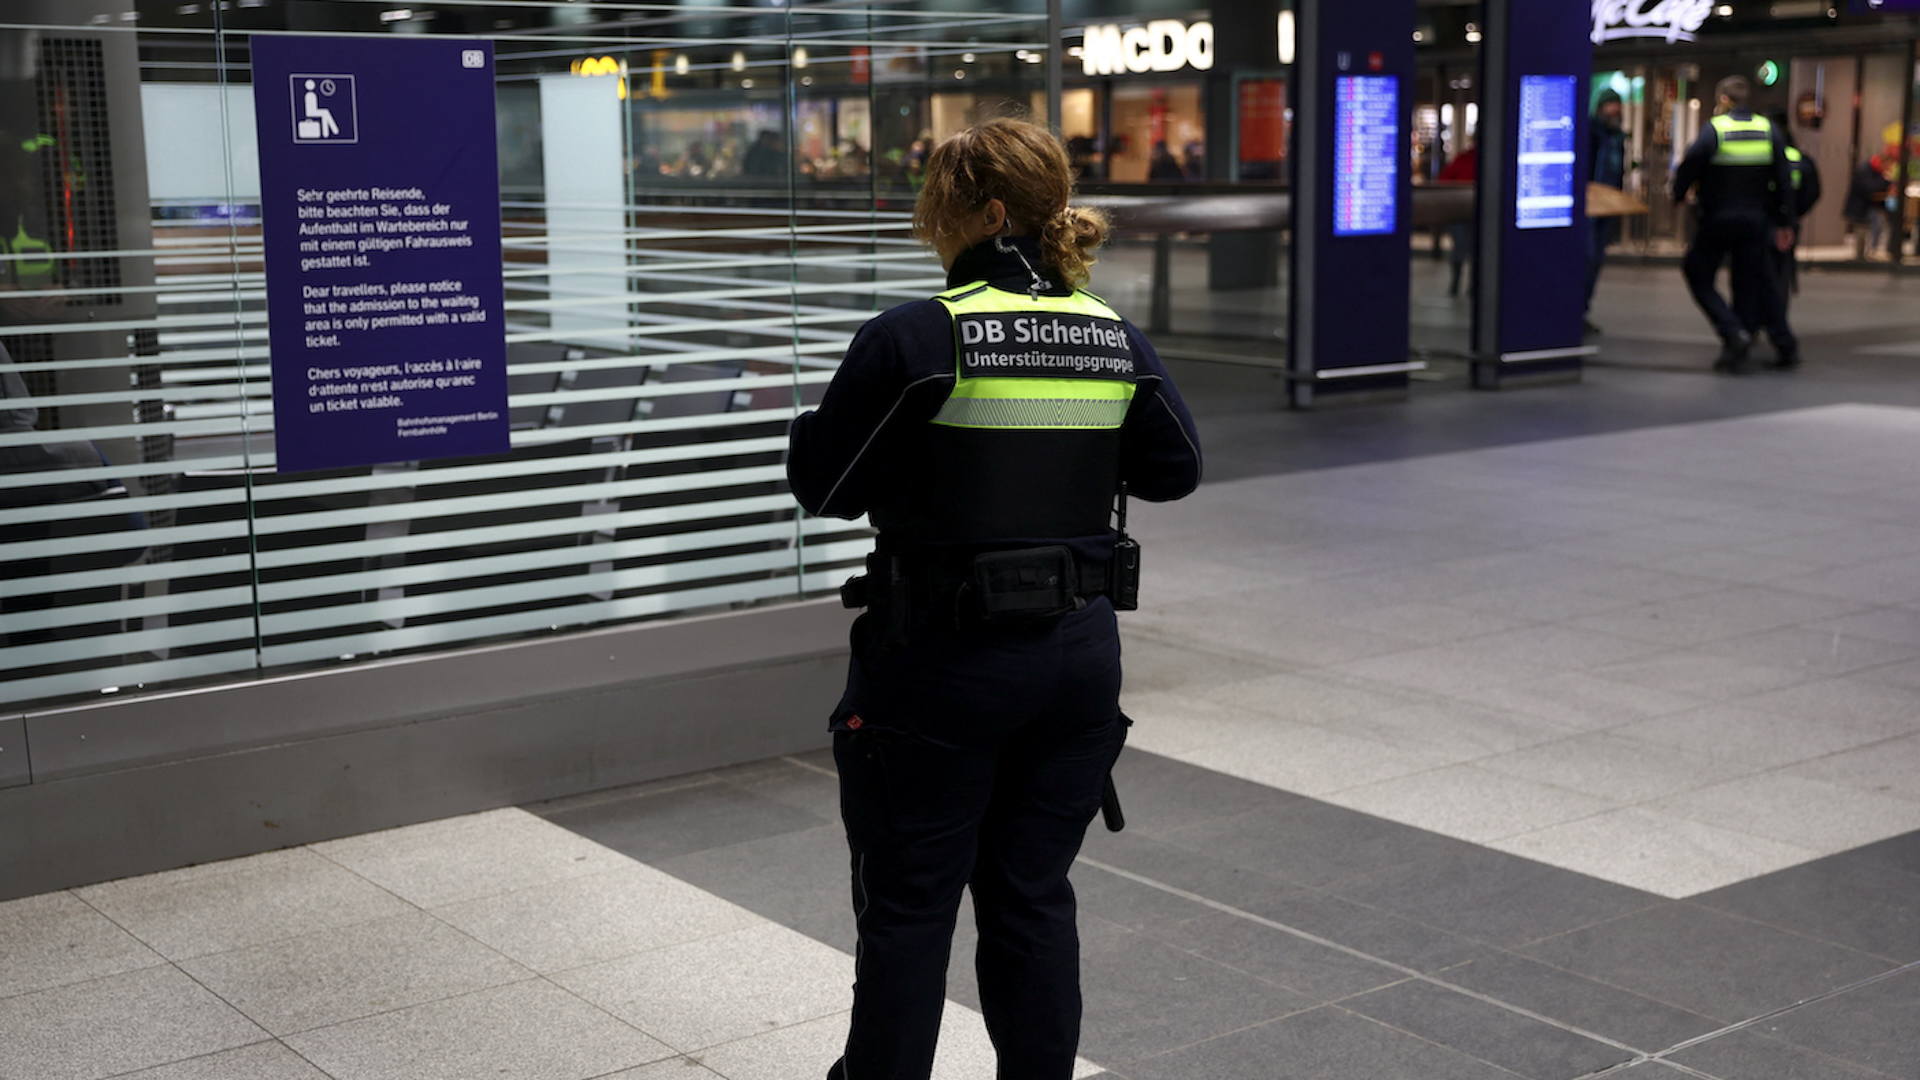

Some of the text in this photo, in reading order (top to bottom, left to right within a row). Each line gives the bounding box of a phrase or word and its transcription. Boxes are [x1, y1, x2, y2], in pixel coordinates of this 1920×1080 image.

[297, 187, 426, 204] Sehr geehrte Reisende,
[298, 203, 451, 218] bitte beachten Sie, dass der
[299, 219, 468, 235] Aufenthalt im Wartebereich nur
[300, 234, 473, 253] mit einem gültigen Fahrausweis
[301, 254, 371, 272] gestattet ist.
[302, 279, 463, 299] Dear travellers, please notice
[304, 294, 480, 315] that the admission to the waiting
[304, 309, 487, 332] area is only permitted with a valid
[305, 334, 341, 348] ticket.
[961, 317, 1130, 350] DB Sicherheit
[307, 367, 341, 381] Chers
[342, 364, 403, 380] voyageurs,
[445, 358, 454, 372] à
[965, 351, 1134, 373] Unterstützungsgruppe
[309, 394, 404, 414] un ticket valable.
[476, 411, 499, 421] Berlin
